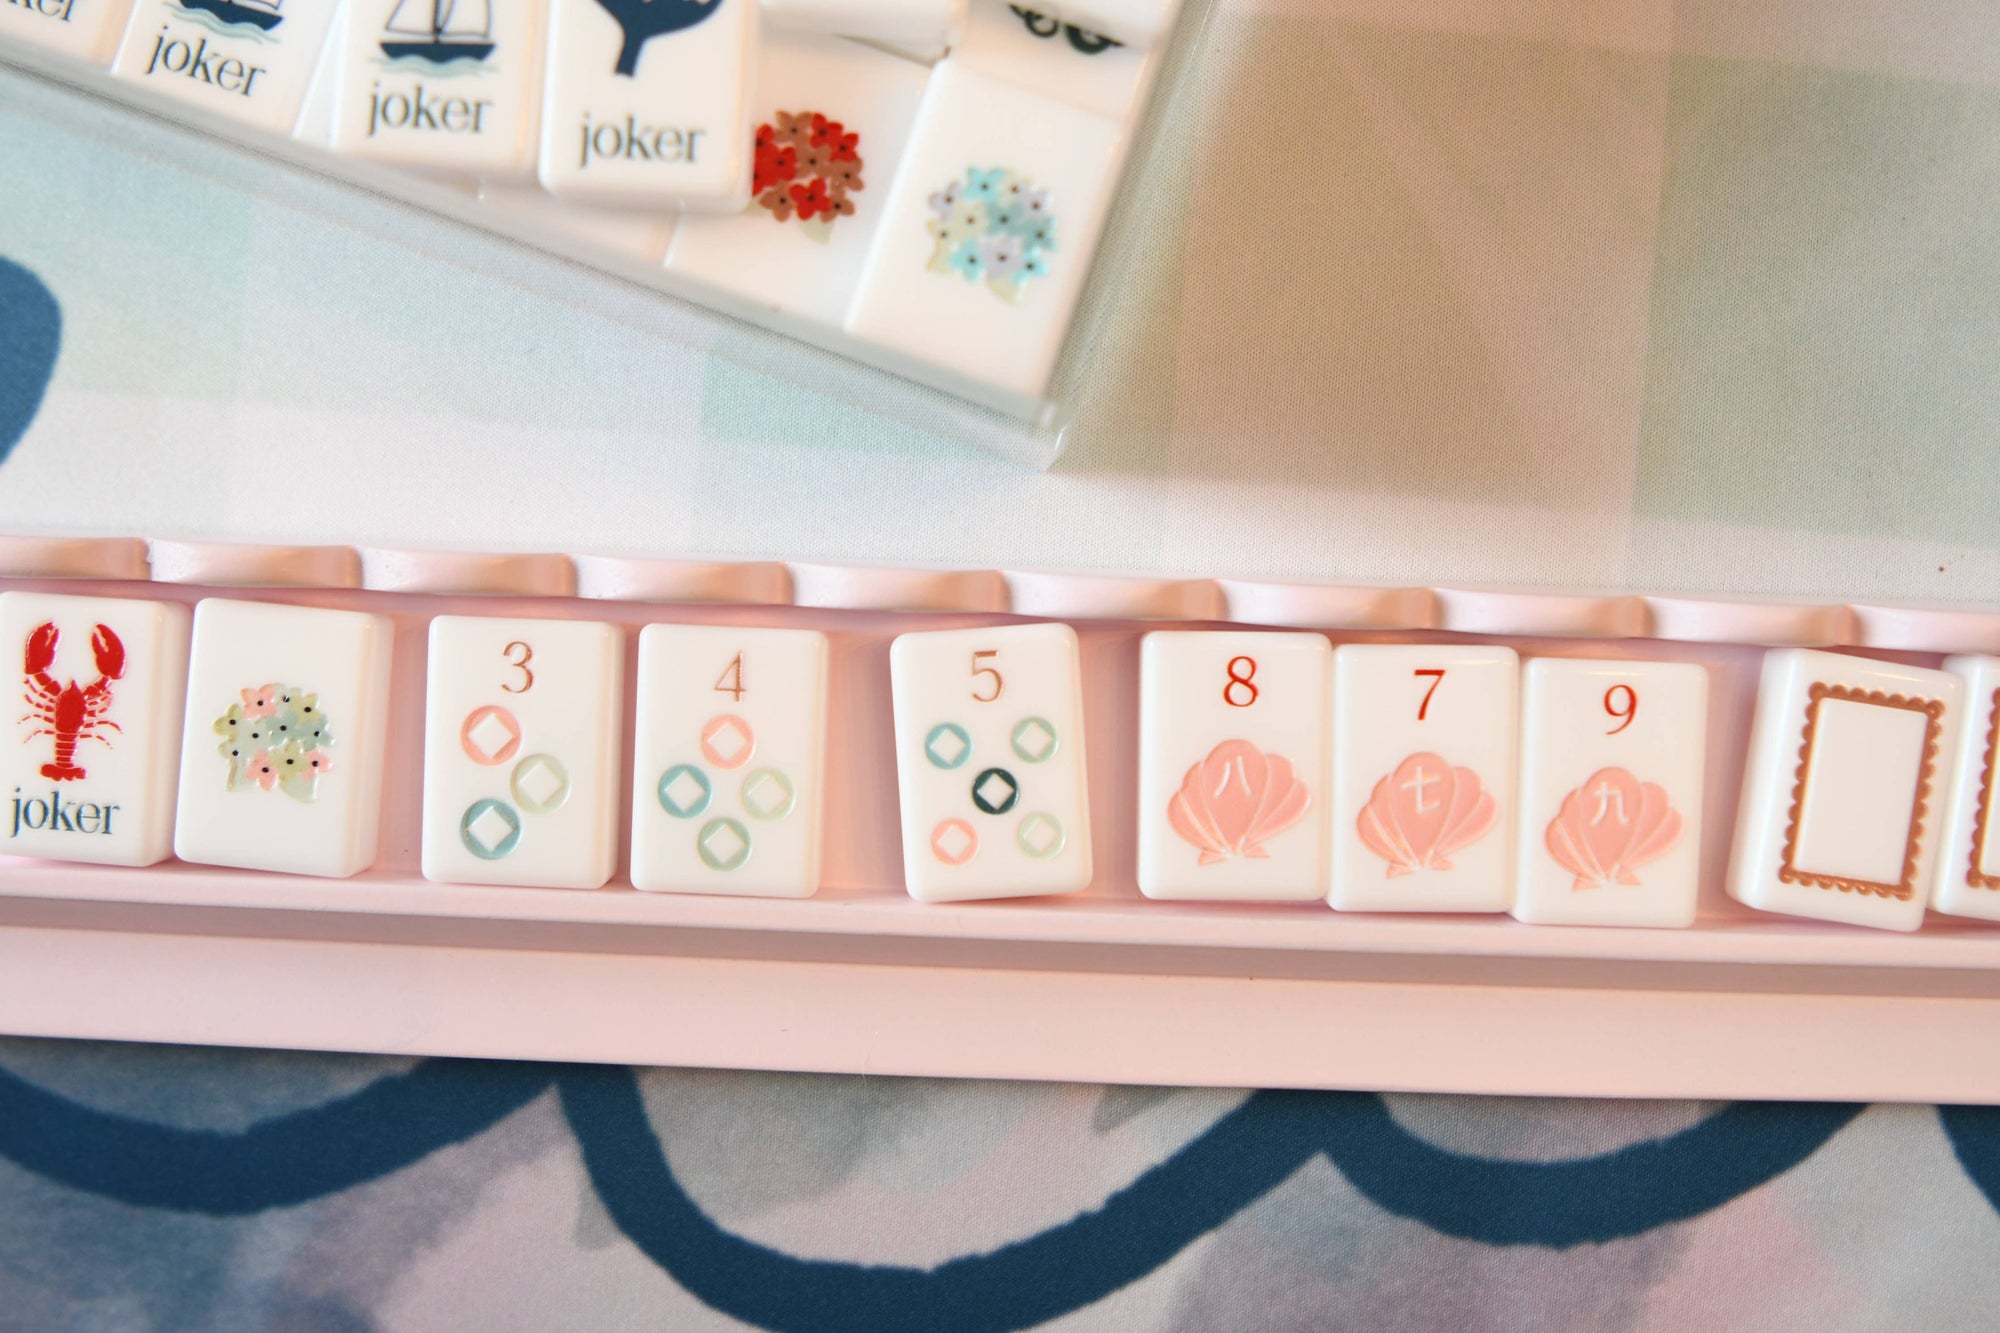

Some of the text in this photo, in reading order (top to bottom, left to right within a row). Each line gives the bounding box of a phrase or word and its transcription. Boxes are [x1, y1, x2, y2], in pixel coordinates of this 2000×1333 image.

[147, 26, 266, 97] joker
[368, 82, 492, 137] joker
[580, 114, 705, 169] joker
[502, 641, 534, 694] 3
[714, 651, 747, 702] 4
[971, 650, 1004, 703] 5
[1222, 655, 1260, 708] 8
[1413, 668, 1446, 721] 7
[1603, 684, 1638, 735] 9
[1214, 755, 1252, 798] 八
[1400, 765, 1441, 813] 七
[9, 787, 121, 837] joker
[1592, 782, 1629, 826] 九
